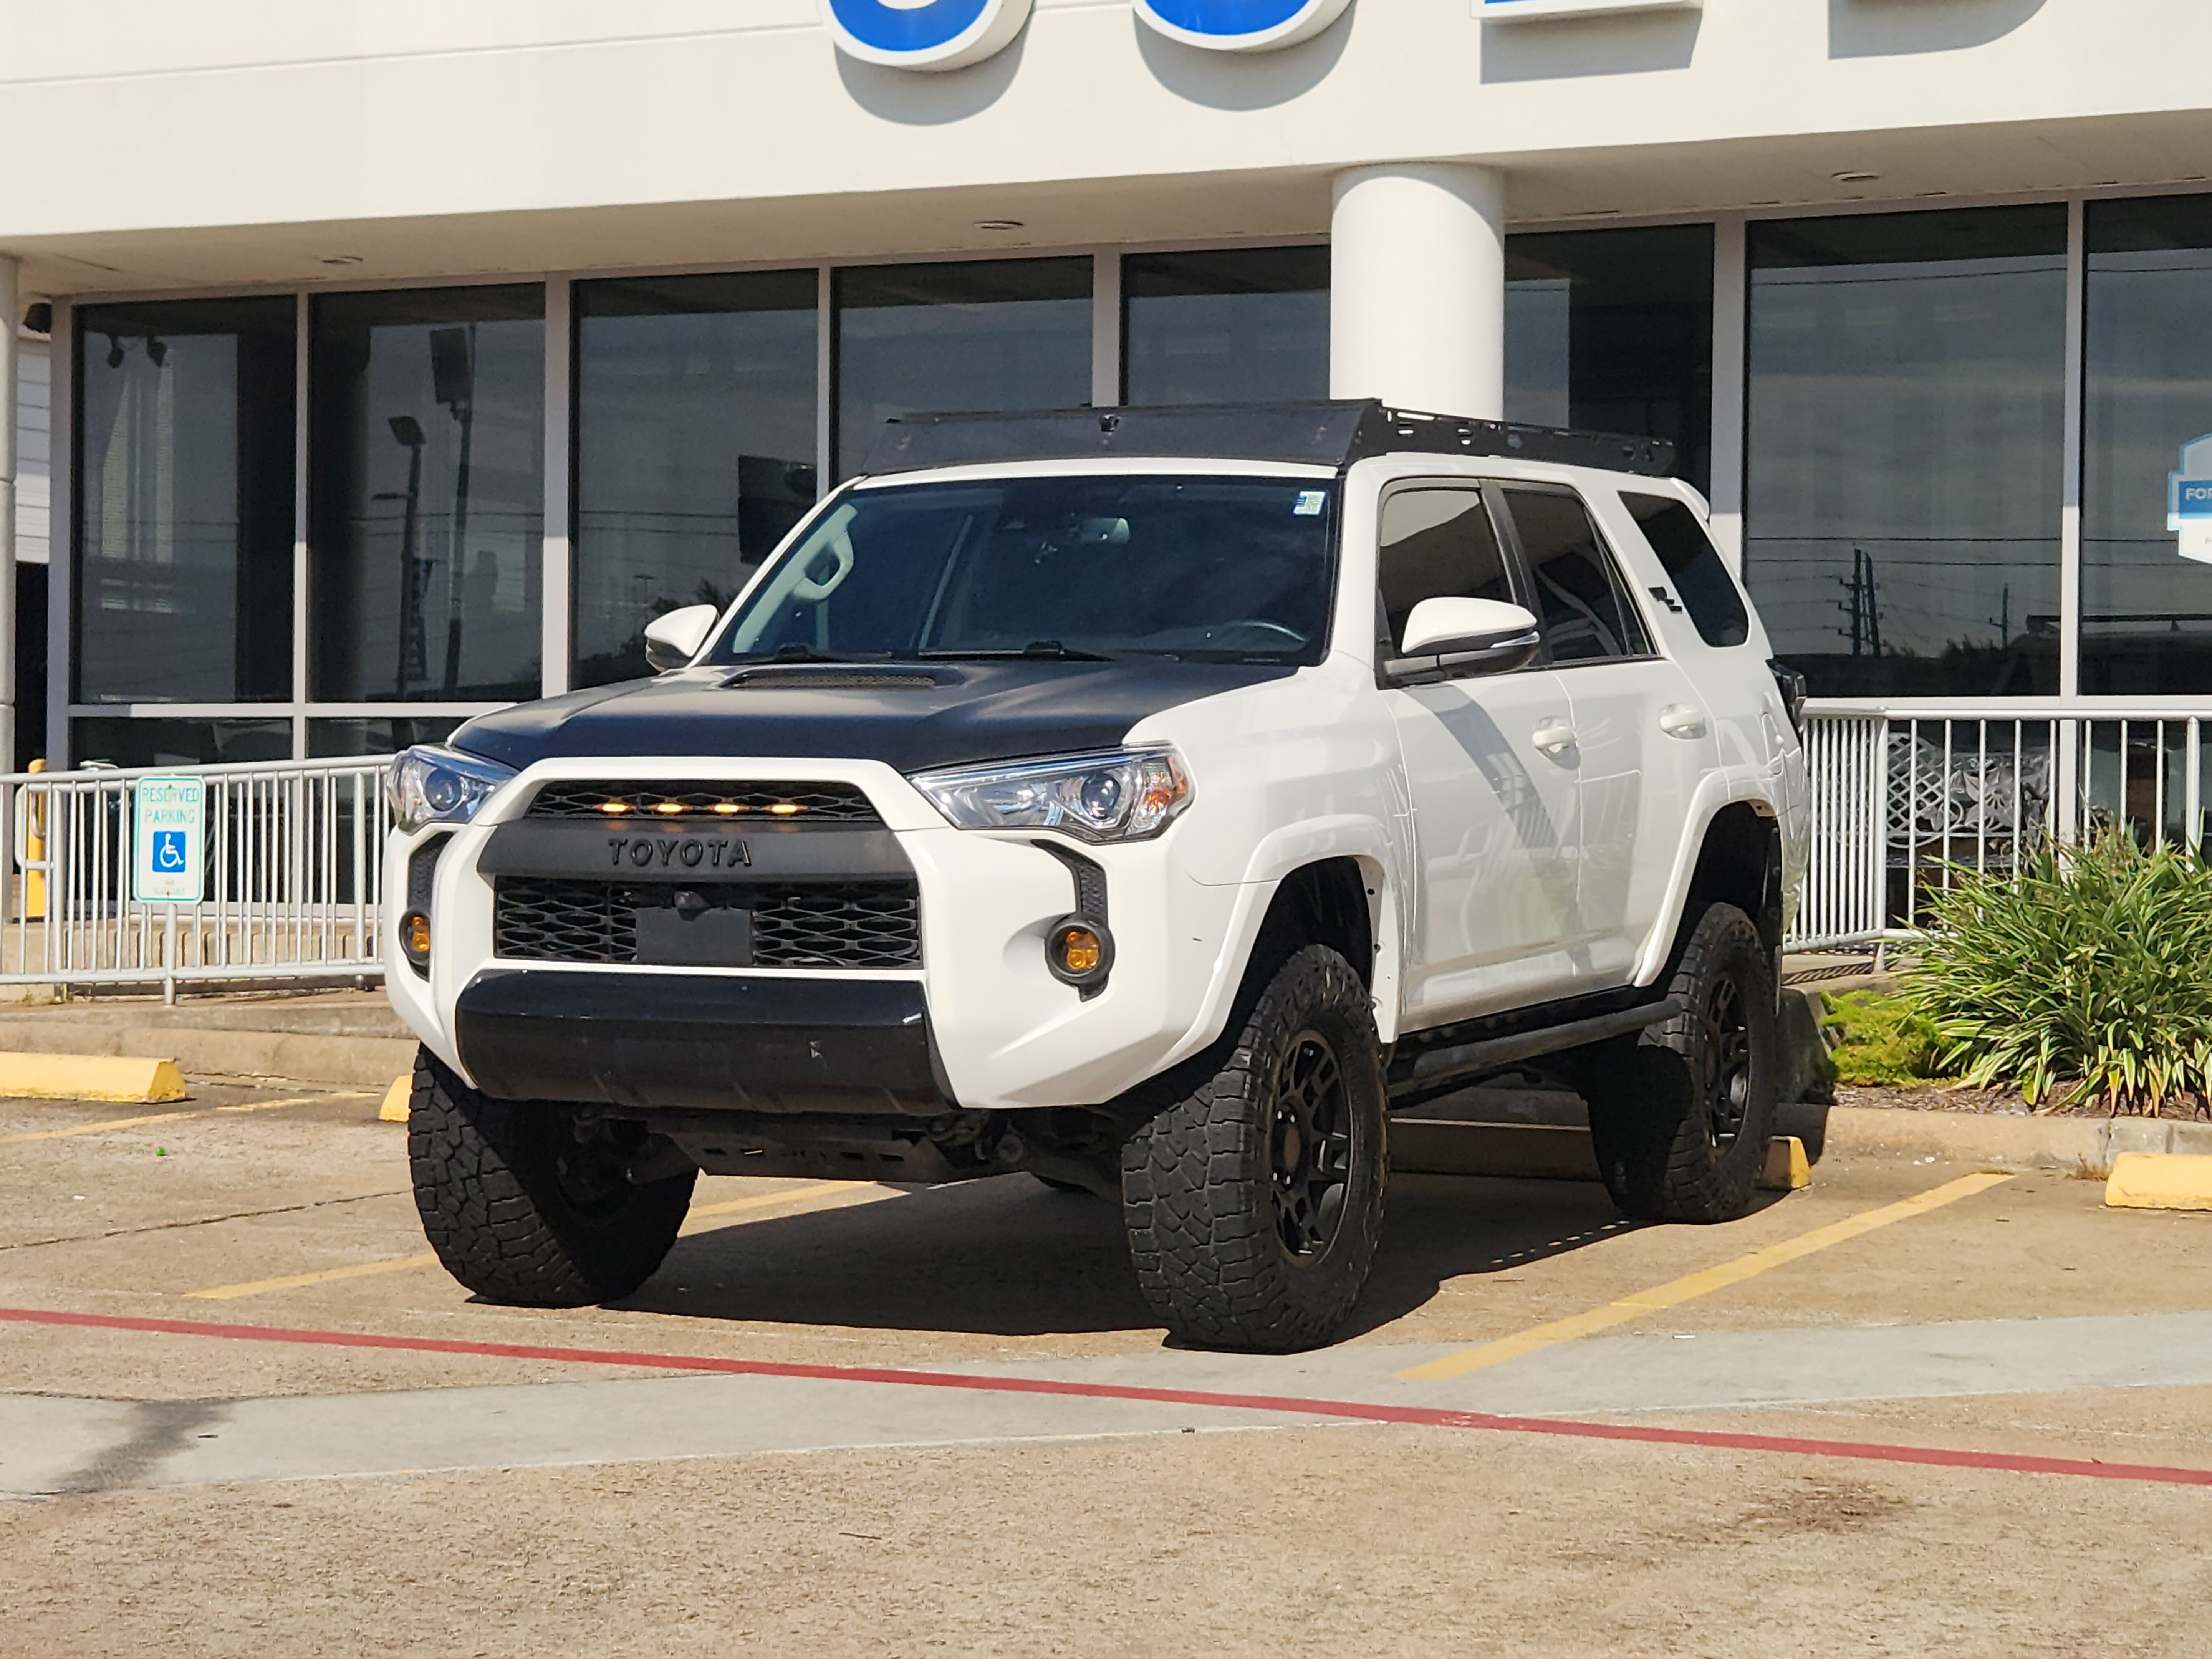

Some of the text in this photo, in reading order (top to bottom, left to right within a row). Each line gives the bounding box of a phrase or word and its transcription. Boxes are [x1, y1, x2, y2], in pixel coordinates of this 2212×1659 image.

[142, 788, 200, 802] RESERVED
[145, 809, 195, 824] PARKING
[608, 839, 752, 867] TOYOTA
